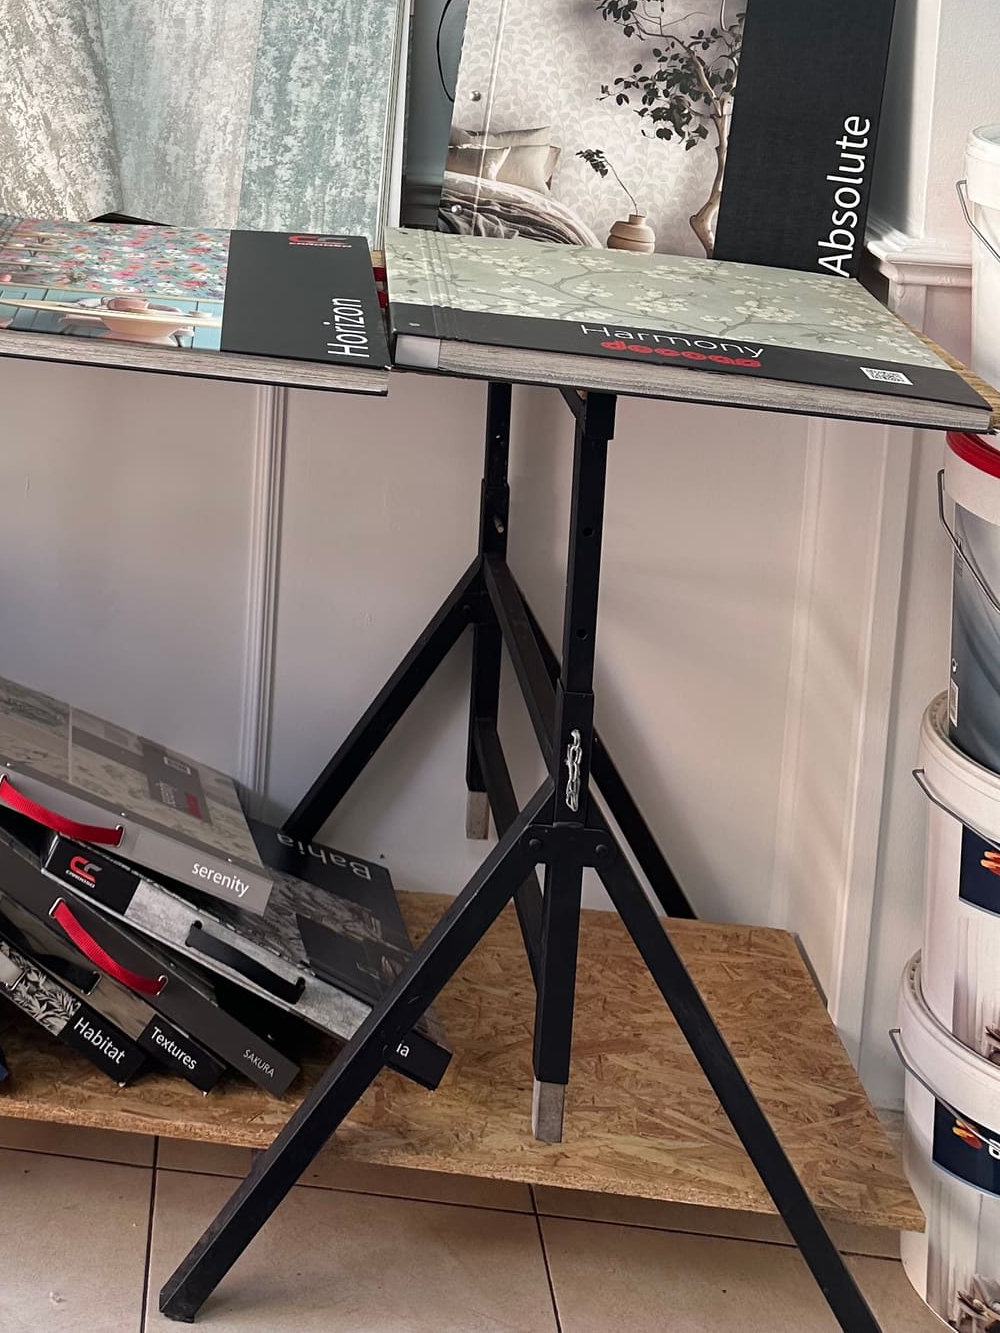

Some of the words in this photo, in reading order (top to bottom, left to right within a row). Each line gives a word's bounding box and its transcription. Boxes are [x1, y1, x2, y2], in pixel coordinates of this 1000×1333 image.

[817, 116, 871, 278] Absolute
[322, 297, 370, 358] Horizon
[580, 324, 765, 358] Harmony
[191, 862, 250, 898] serenity
[276, 833, 373, 881] Bahia
[73, 1016, 126, 1065] Habitat
[150, 1026, 198, 1071] Textures
[242, 1048, 276, 1078] SAKURA
